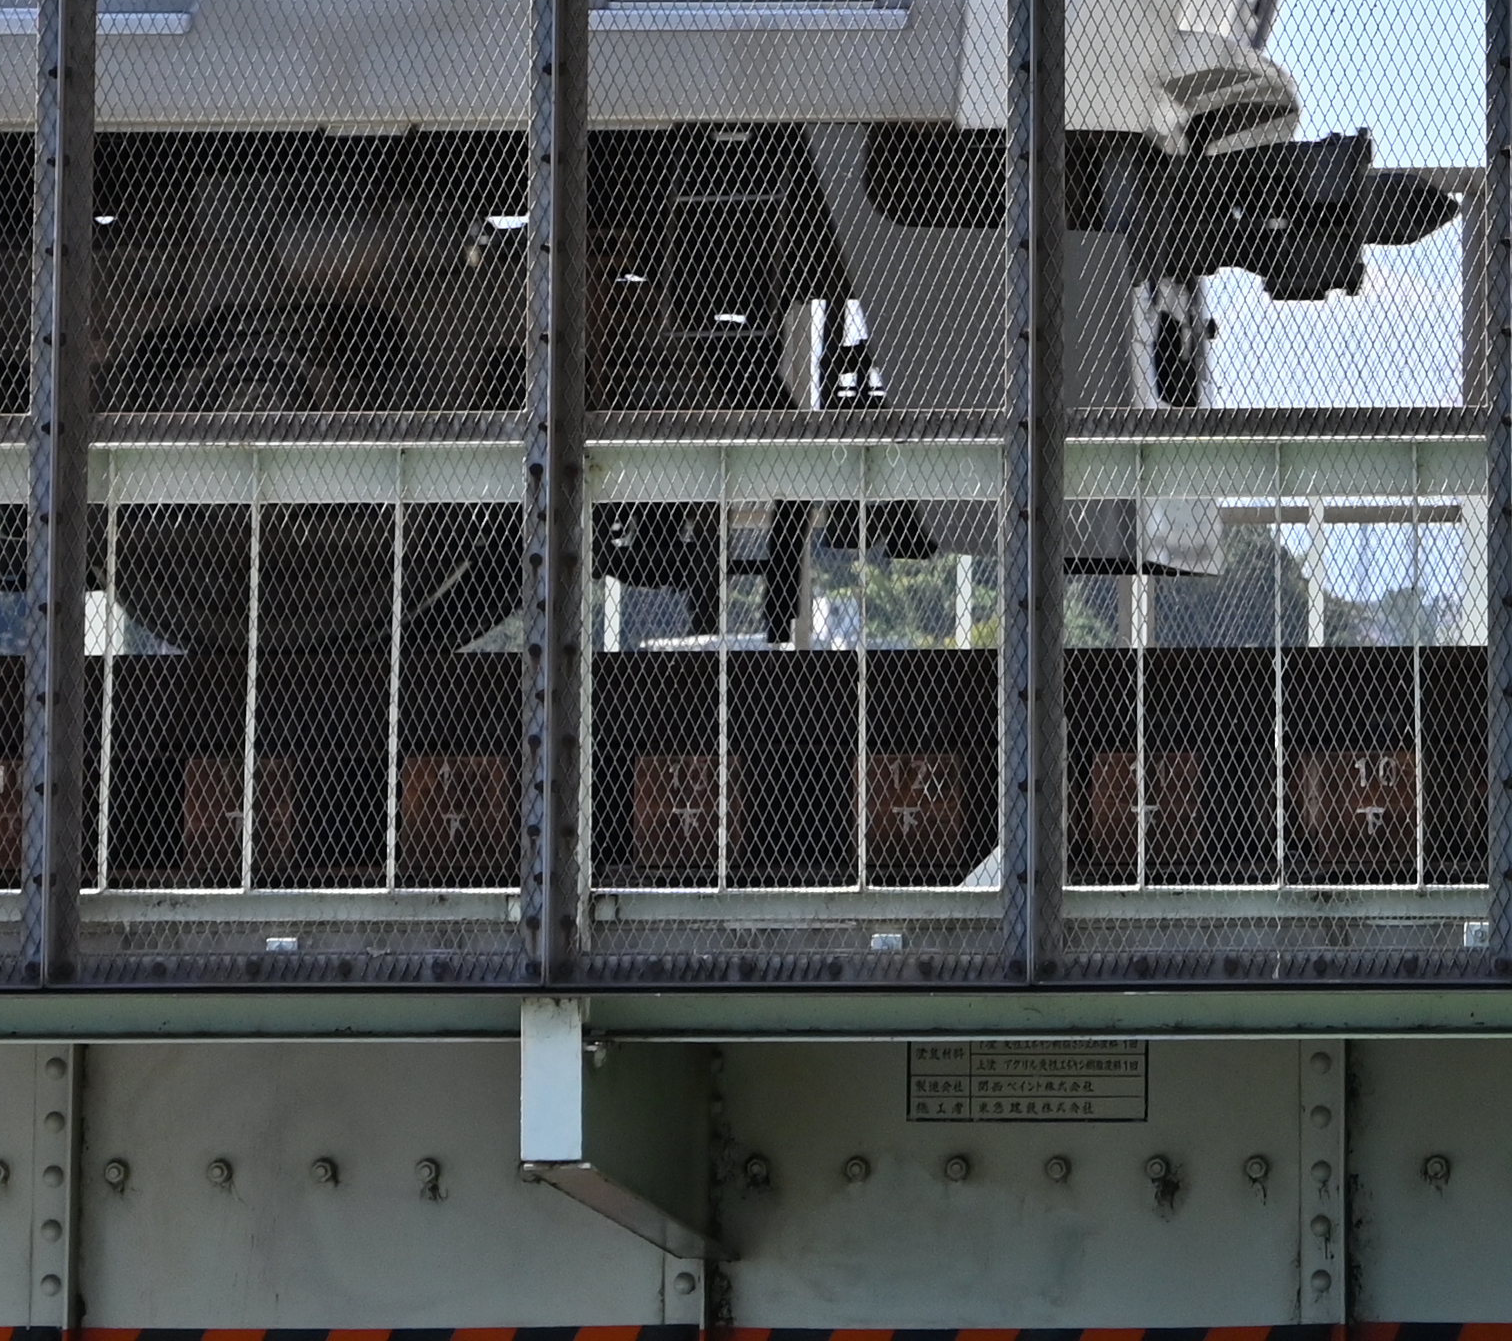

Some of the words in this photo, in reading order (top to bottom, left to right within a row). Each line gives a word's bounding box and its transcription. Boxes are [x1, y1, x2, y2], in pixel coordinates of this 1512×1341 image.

[1354, 756, 1397, 788] 10
[892, 805, 921, 834] 下
[1356, 805, 1385, 835] 下
